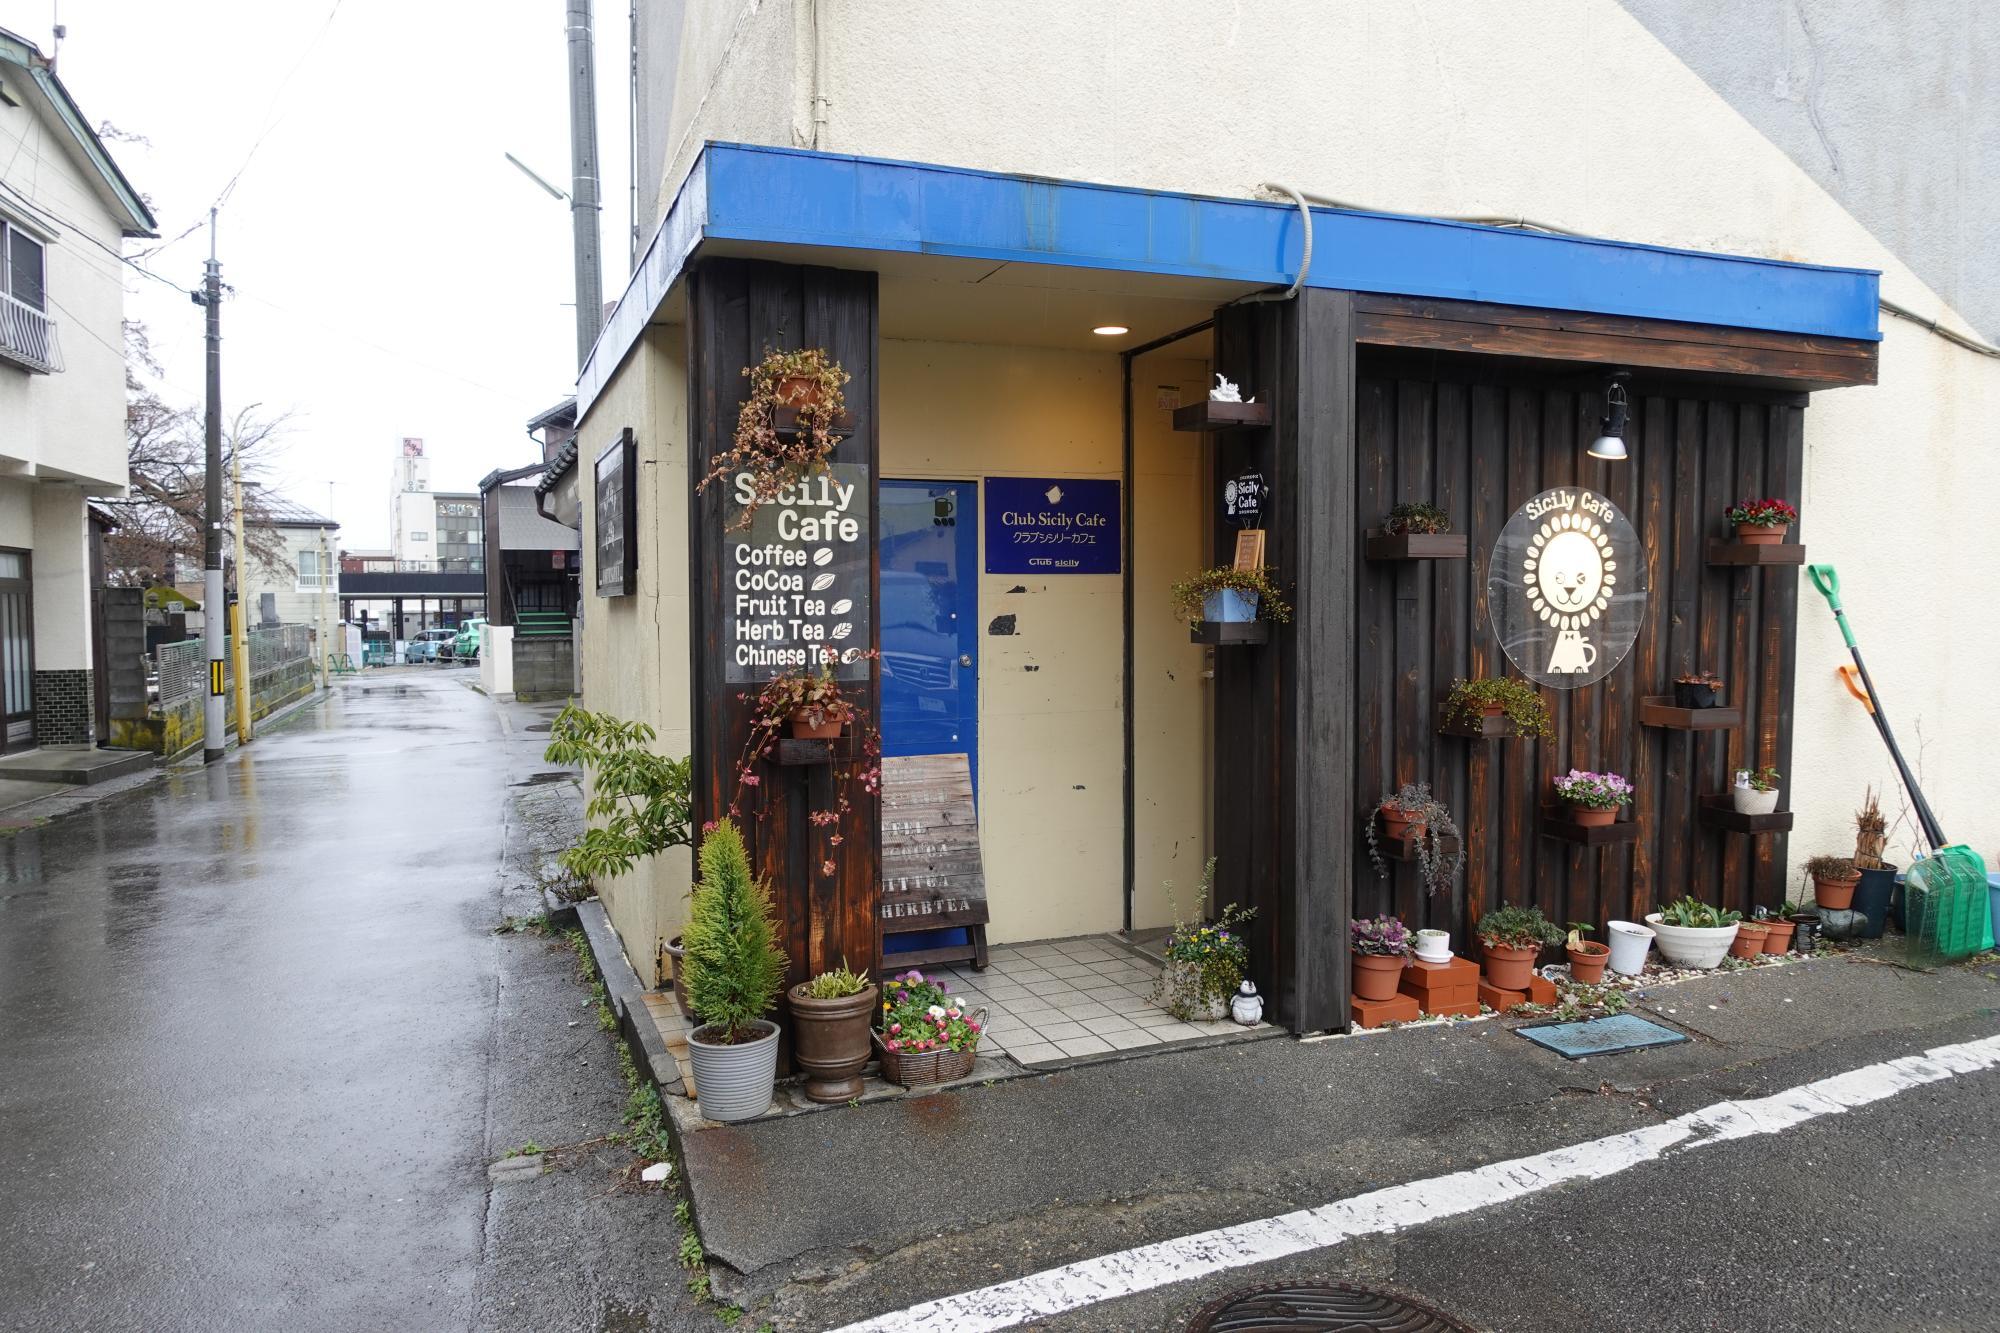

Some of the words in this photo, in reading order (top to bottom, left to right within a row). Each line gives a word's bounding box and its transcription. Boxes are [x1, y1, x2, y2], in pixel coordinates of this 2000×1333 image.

[735, 472, 854, 511] Scily
[1238, 481, 1260, 495] Sicily
[1238, 495, 1257, 508] Cafe
[1525, 490, 1576, 521] Sicily
[1581, 491, 1615, 524] Cafe
[778, 509, 859, 542] Cafe
[1002, 512, 1036, 526] Club
[1039, 512, 1073, 530] Sicily
[1076, 512, 1107, 527] Cafe
[1013, 531, 1096, 544] クラブシシリーカフェ
[735, 543, 807, 566] Coffee
[735, 569, 804, 592] CoCoa
[735, 594, 788, 616] Fruit
[791, 594, 826, 616] Tea
[736, 619, 785, 641] Herb
[789, 619, 825, 641] Tea
[735, 644, 806, 666] Chinese
